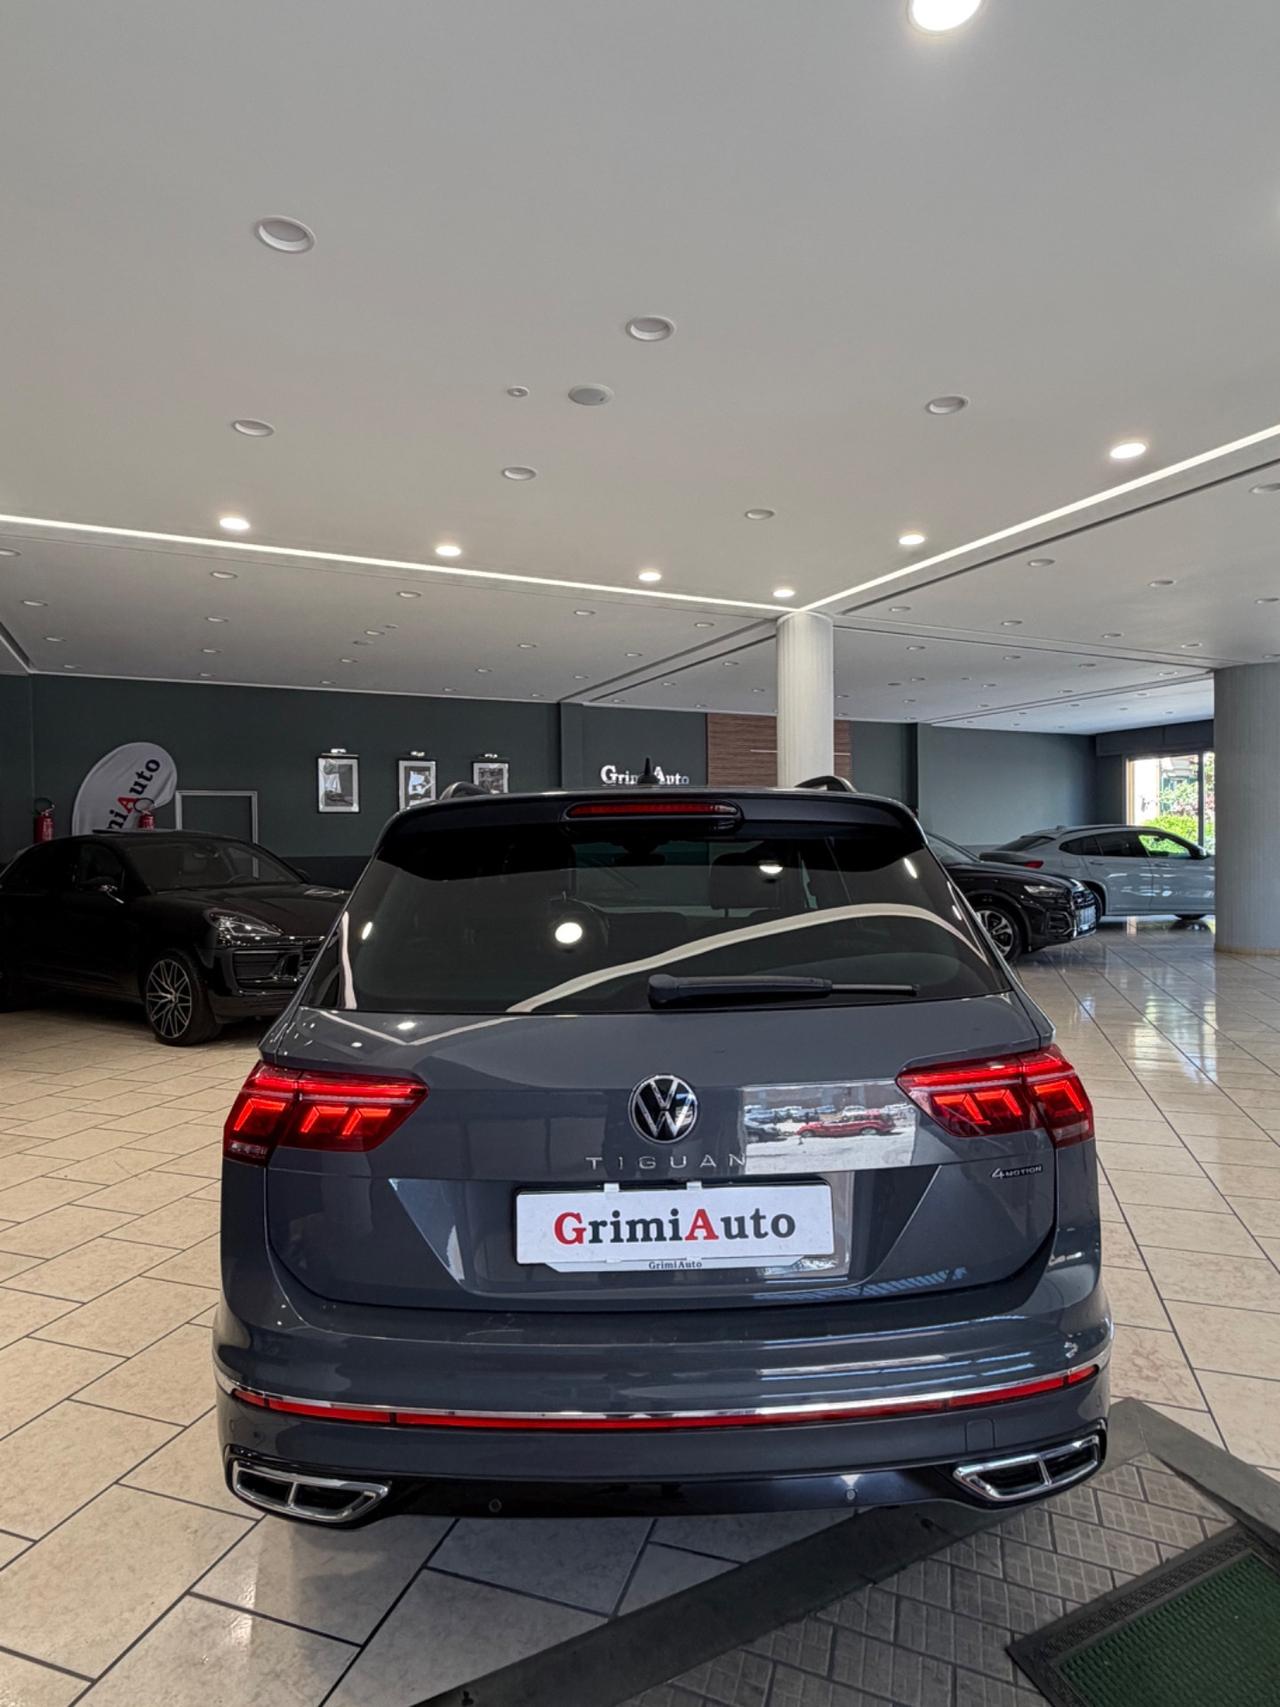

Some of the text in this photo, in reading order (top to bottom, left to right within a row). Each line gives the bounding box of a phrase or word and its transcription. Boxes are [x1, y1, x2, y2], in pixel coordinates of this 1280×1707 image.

[585, 1152, 746, 1170] TIGUAN
[553, 1207, 796, 1245] GrimiAuto
[648, 1261, 702, 1269] GrimiAuto
